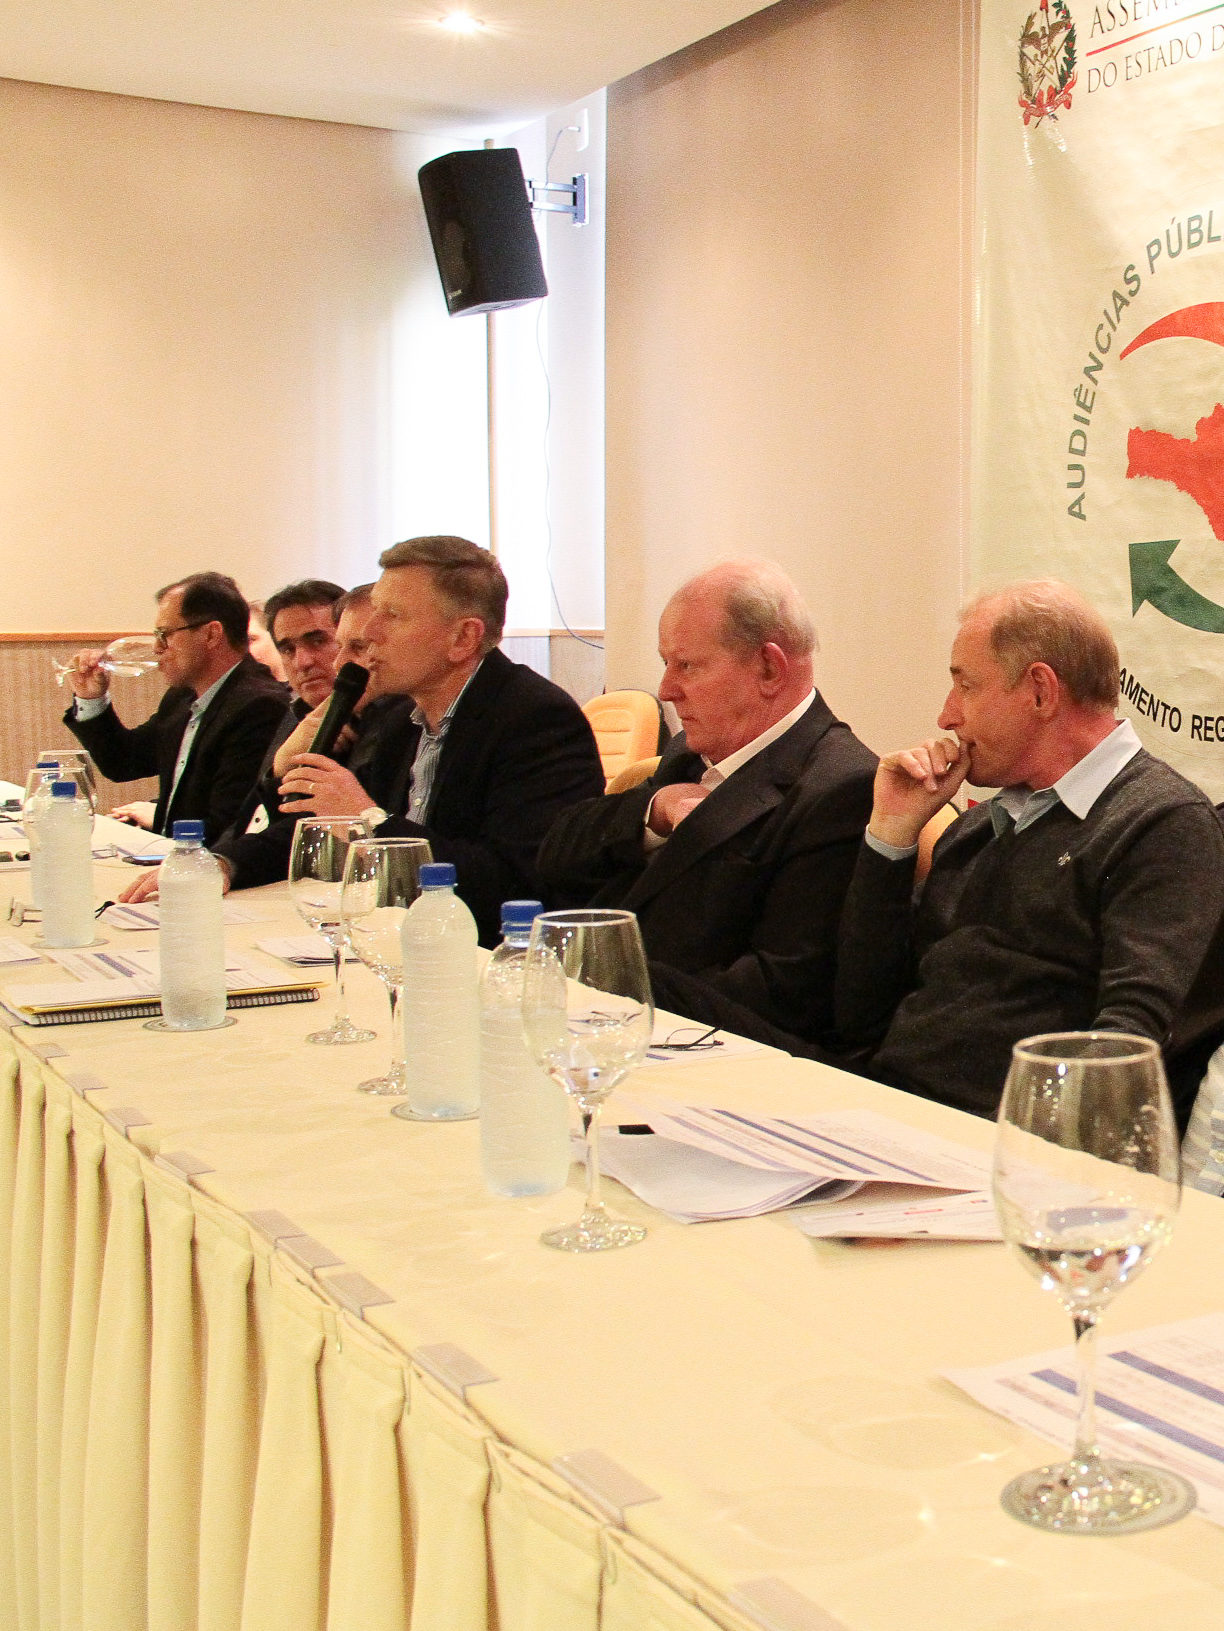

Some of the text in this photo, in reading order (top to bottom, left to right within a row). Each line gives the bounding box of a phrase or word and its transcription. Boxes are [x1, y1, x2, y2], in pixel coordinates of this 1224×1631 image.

[1087, 61, 1118, 94] DO
[1124, 31, 1202, 82] ESTADO
[1066, 263, 1142, 522] AUDIÊNCIAS
